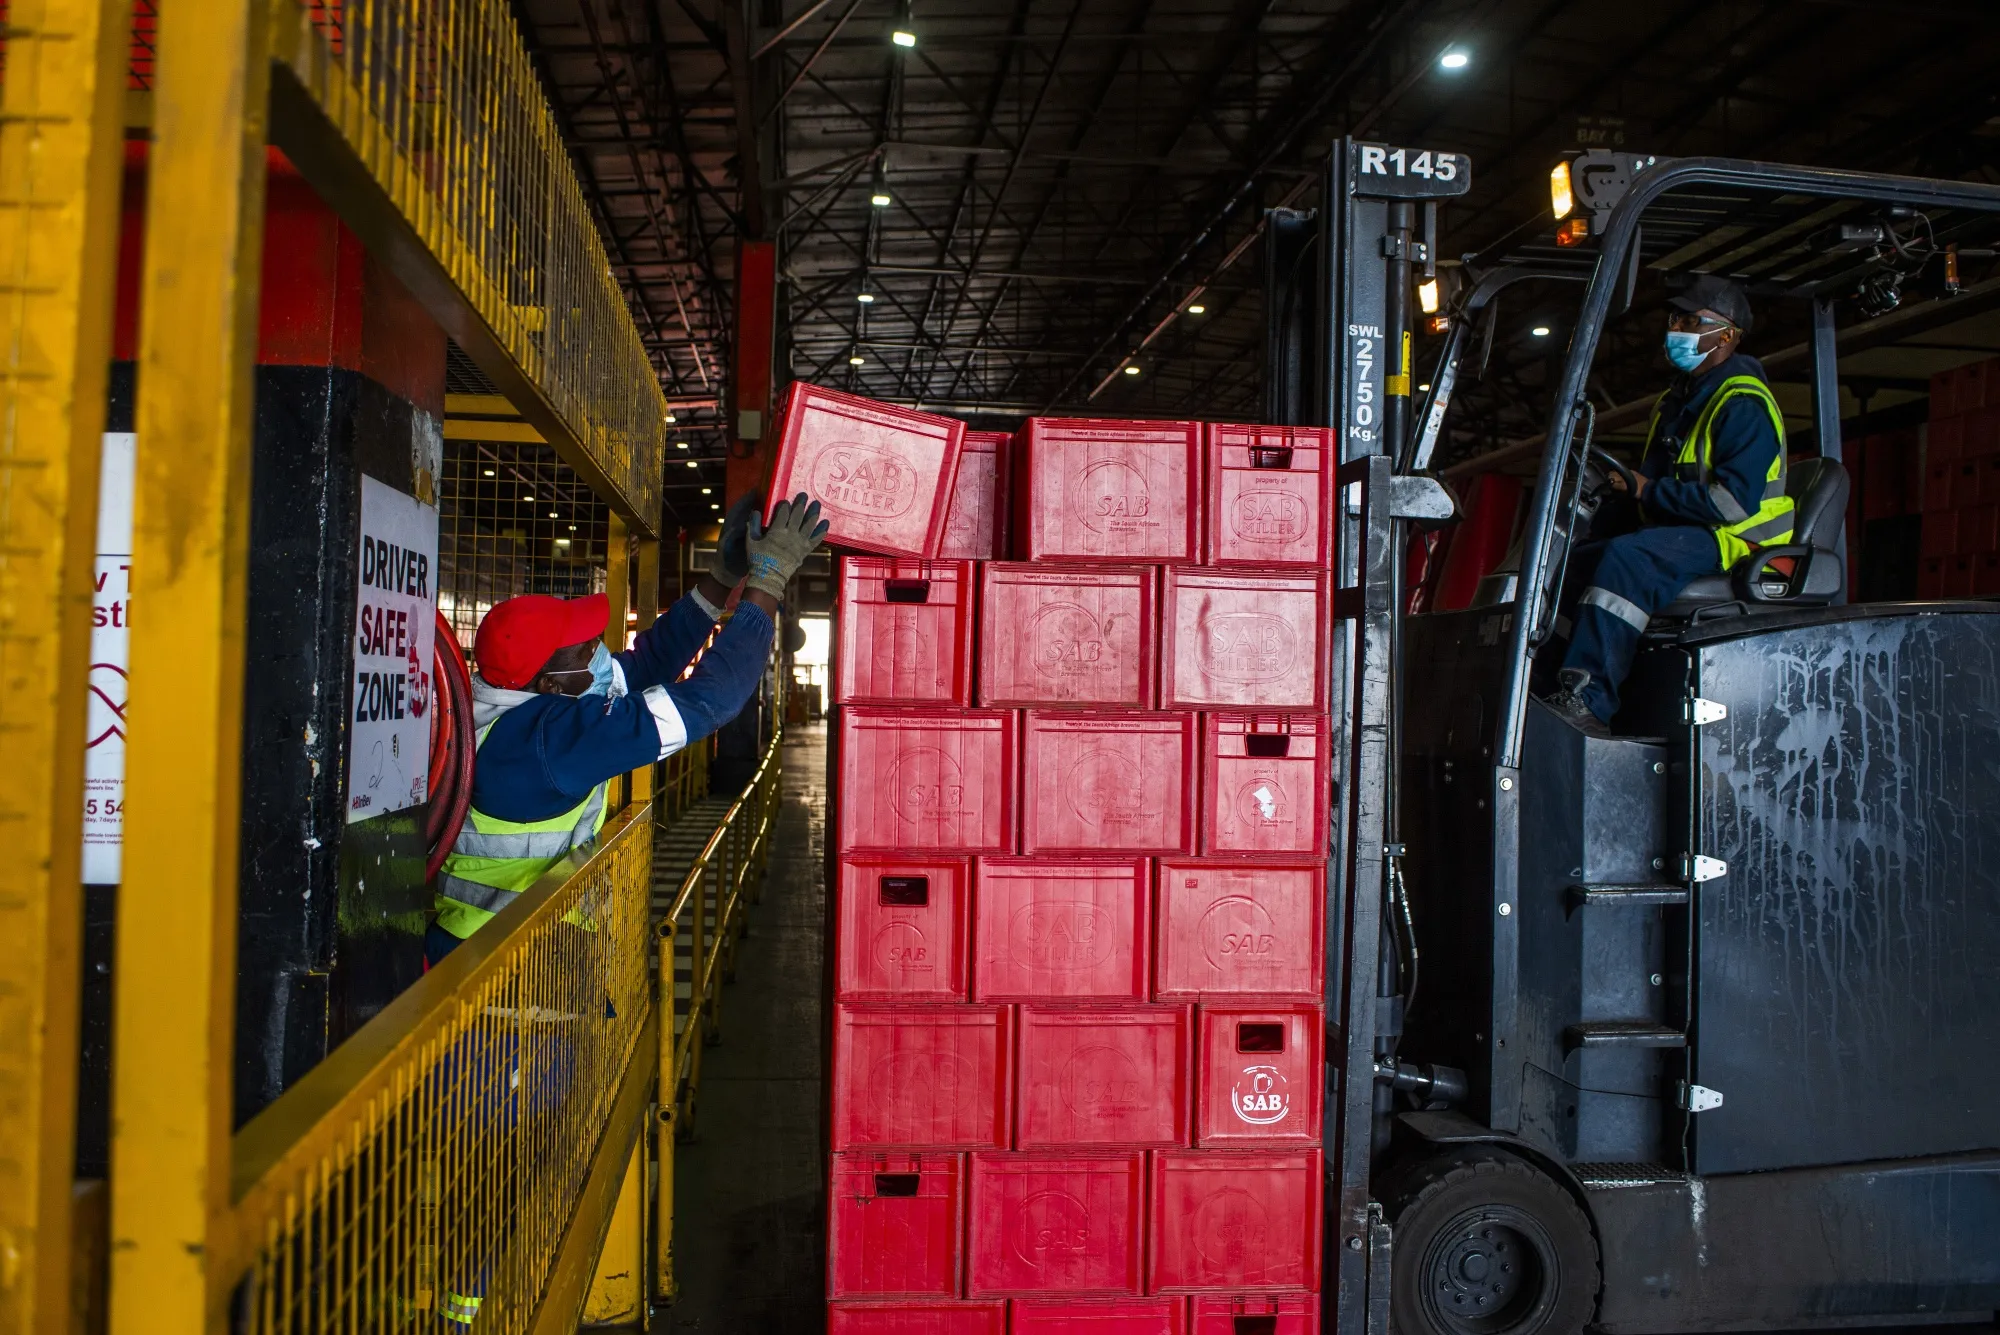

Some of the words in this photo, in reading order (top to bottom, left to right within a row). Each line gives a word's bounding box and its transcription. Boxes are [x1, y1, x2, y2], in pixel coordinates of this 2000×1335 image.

[1362, 146, 1457, 181] R145
[1349, 325, 1383, 338] SWL
[1356, 339, 1373, 425] 2750
[1350, 427, 1376, 441] Kg.
[828, 451, 902, 494] SAB
[1256, 477, 1279, 485] property
[824, 484, 896, 513] MILLER
[1095, 496, 1150, 517] SAB
[1244, 498, 1295, 521] SAB
[1243, 522, 1295, 535] MILLER
[363, 534, 429, 599] DRIVER
[360, 604, 407, 658] SAFE
[1212, 624, 1283, 655] SAB
[1047, 641, 1102, 661] SAB
[1211, 656, 1279, 672] MILLER
[356, 672, 405, 722] ZONE
[84, 799, 98, 815] 5
[907, 785, 965, 807] SAB
[1027, 912, 1098, 943] SAB
[889, 947, 928, 962] SAB
[1220, 933, 1275, 955] SAB
[1083, 1080, 1140, 1103] SAB
[1243, 1095, 1282, 1111] SAB
